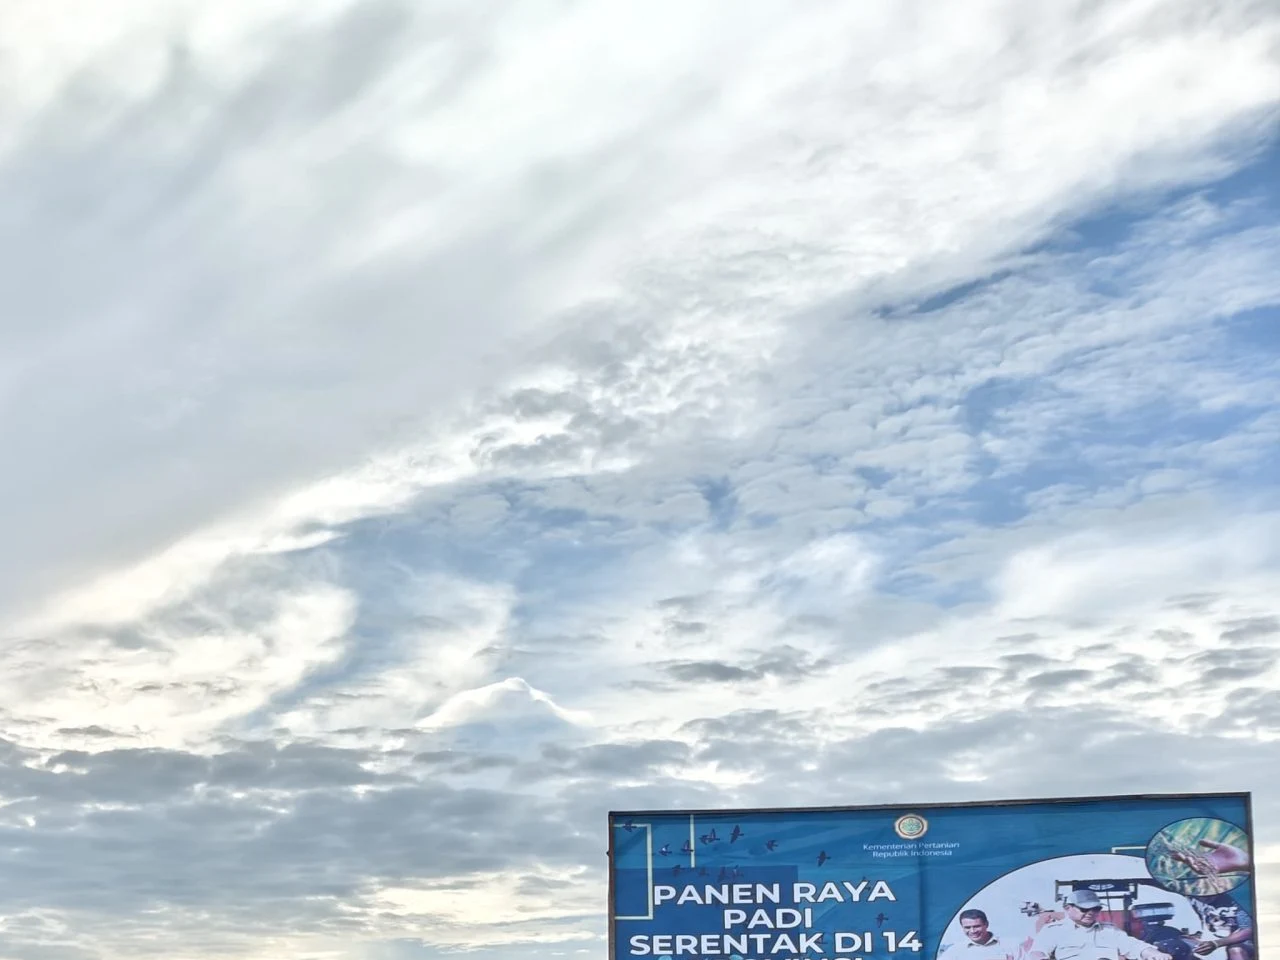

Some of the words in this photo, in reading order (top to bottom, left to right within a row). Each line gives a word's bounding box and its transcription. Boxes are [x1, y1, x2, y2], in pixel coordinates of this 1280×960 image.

[872, 850, 908, 858] Republik
[910, 849, 953, 857] Indonesia
[653, 883, 780, 906] PANEN
[793, 880, 896, 903] RAYA
[723, 908, 812, 930] PADI
[629, 932, 825, 955] SERENTAK
[834, 932, 872, 953] DI
[882, 931, 923, 952] 14
